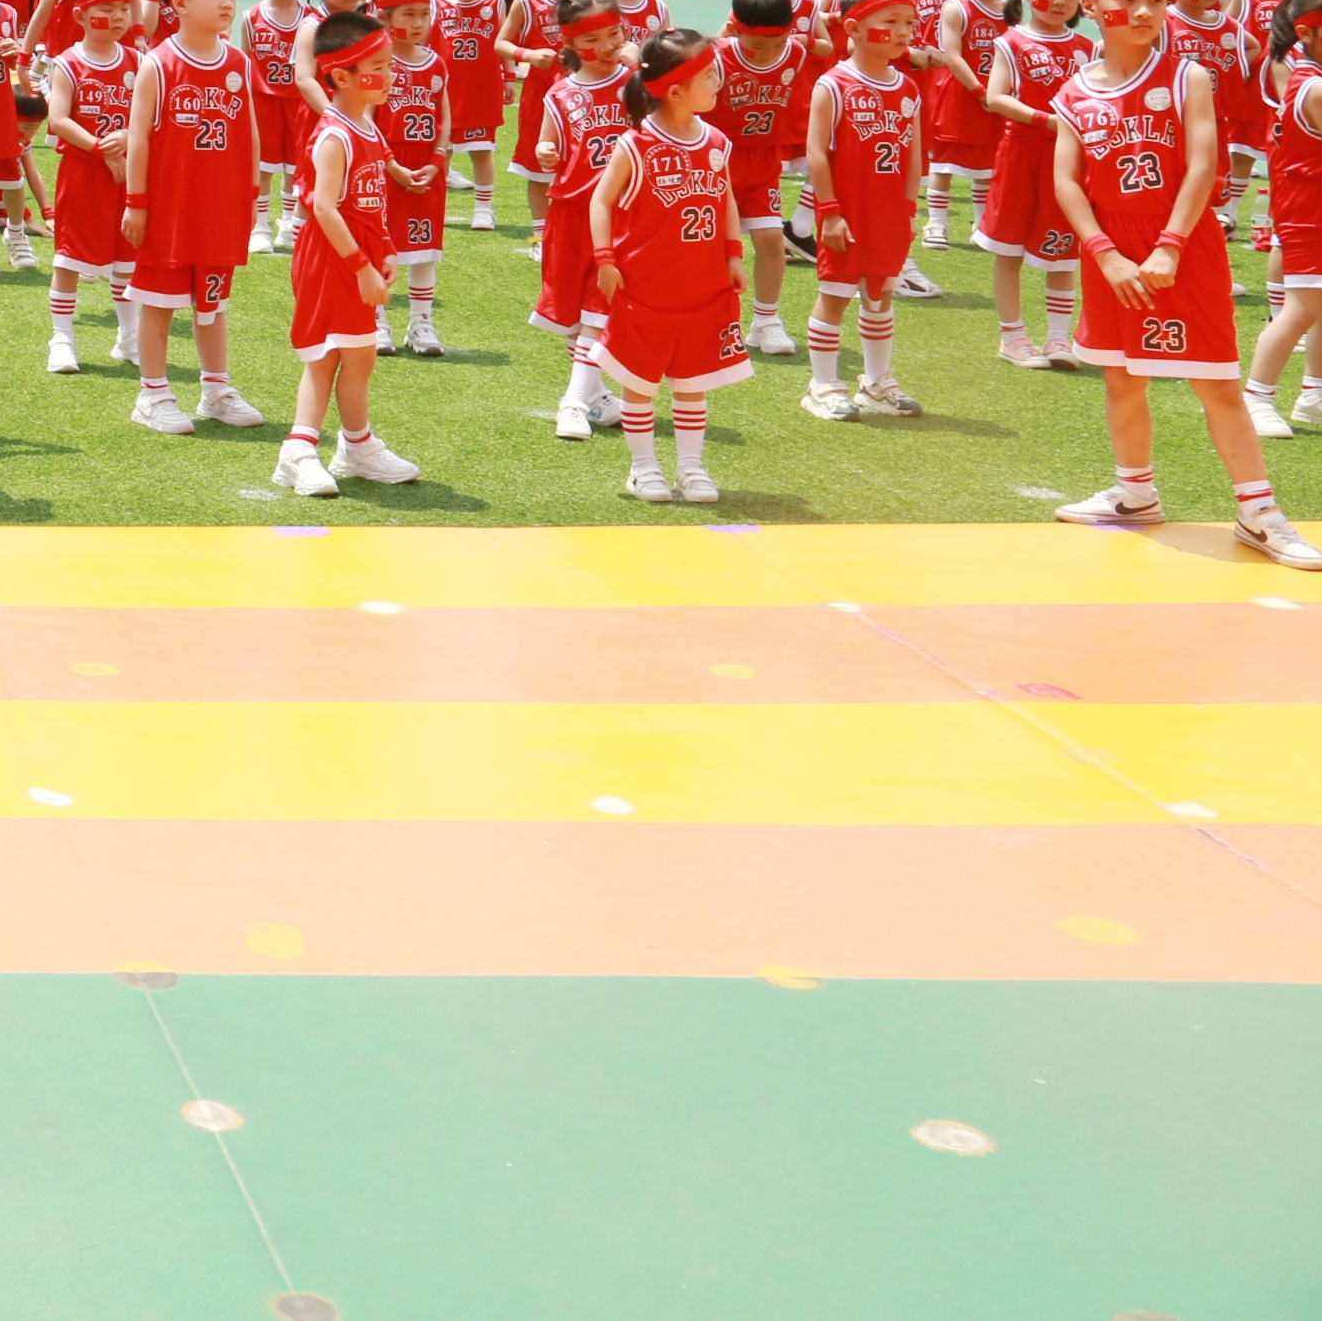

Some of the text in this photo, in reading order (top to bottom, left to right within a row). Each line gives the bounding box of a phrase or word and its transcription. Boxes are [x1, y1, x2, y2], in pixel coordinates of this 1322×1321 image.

[254, 31, 274, 44] 177
[974, 27, 993, 39] 184
[452, 38, 478, 60] 23
[1176, 39, 1199, 51] 187
[978, 53, 992, 75] 2
[1023, 51, 1049, 68] 188
[1204, 44, 1236, 72] KLR
[267, 62, 293, 84] 23
[78, 89, 103, 103] 149
[728, 81, 752, 96] 167
[174, 96, 201, 111] 160
[204, 86, 243, 119] KLR
[849, 95, 876, 109] 166
[95, 113, 126, 138] 23
[404, 113, 436, 141] 23
[742, 111, 775, 135] 23
[1076, 110, 1108, 131] 176
[194, 119, 227, 150] 23
[651, 155, 683, 173] 171
[1116, 151, 1164, 194] 23
[356, 178, 380, 194] 162
[408, 219, 432, 245] 23
[681, 205, 716, 242] 23
[1039, 228, 1074, 256] 23
[719, 321, 745, 360] 23
[1142, 317, 1187, 354] 23
